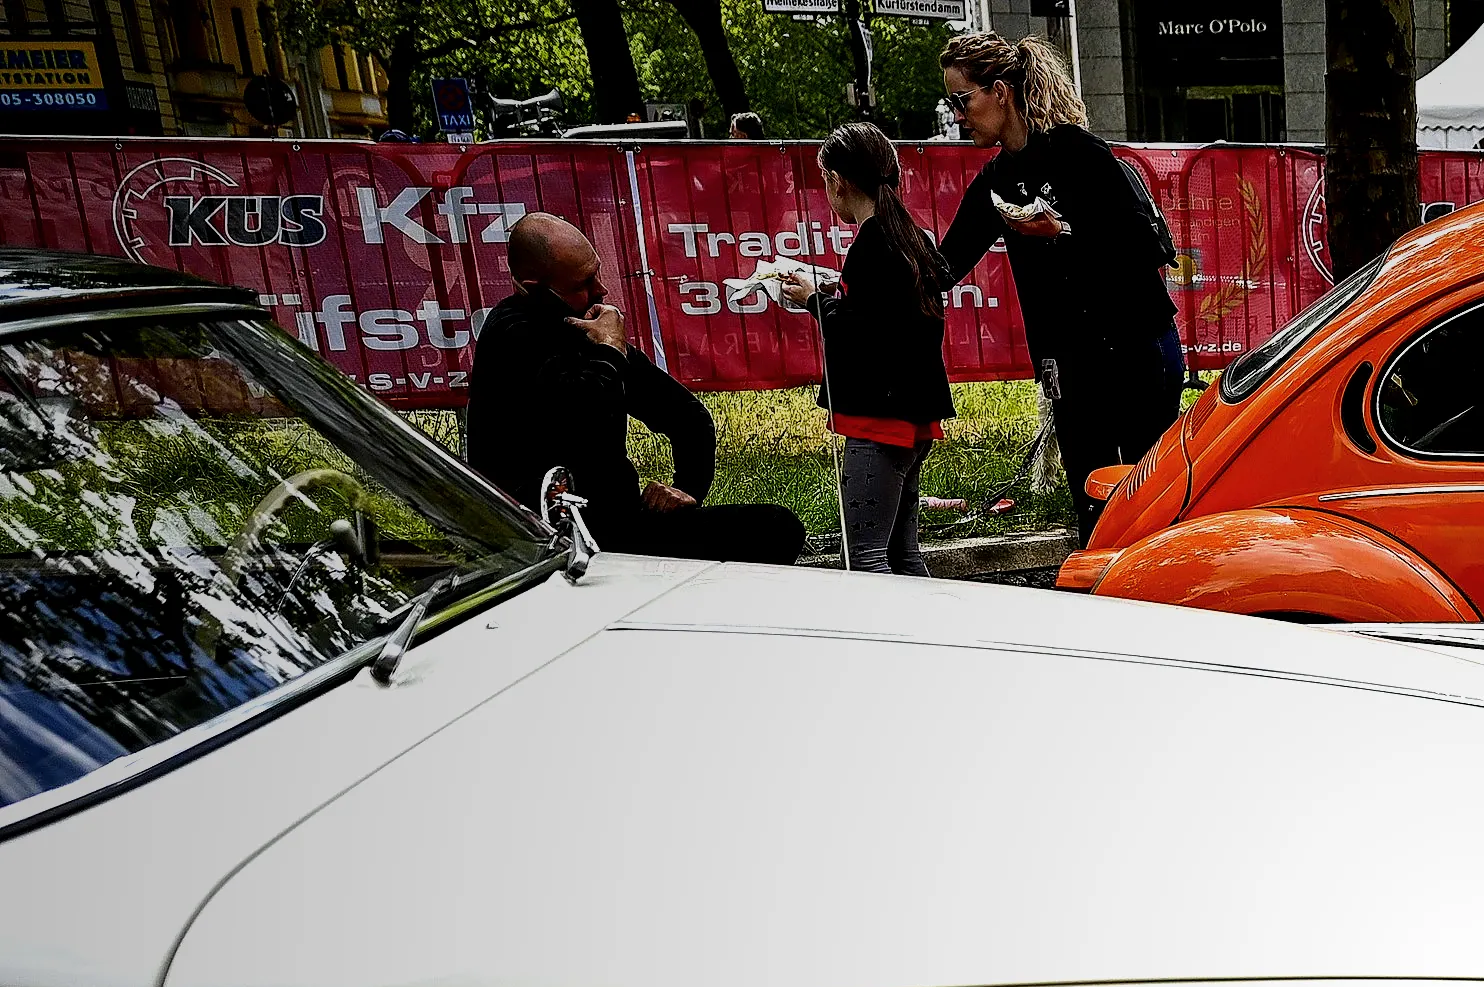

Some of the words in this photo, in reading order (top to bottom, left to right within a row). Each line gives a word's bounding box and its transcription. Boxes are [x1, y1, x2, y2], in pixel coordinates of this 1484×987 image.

[1158, 21, 1204, 36] Marc
[1209, 19, 1267, 34] O'Polo
[0, 72, 89, 84] TSTATION
[441, 114, 471, 127] TAXI
[356, 186, 526, 244] Kfz
[668, 221, 856, 258] Tradit
[1181, 340, 1242, 354] s-v-z.de
